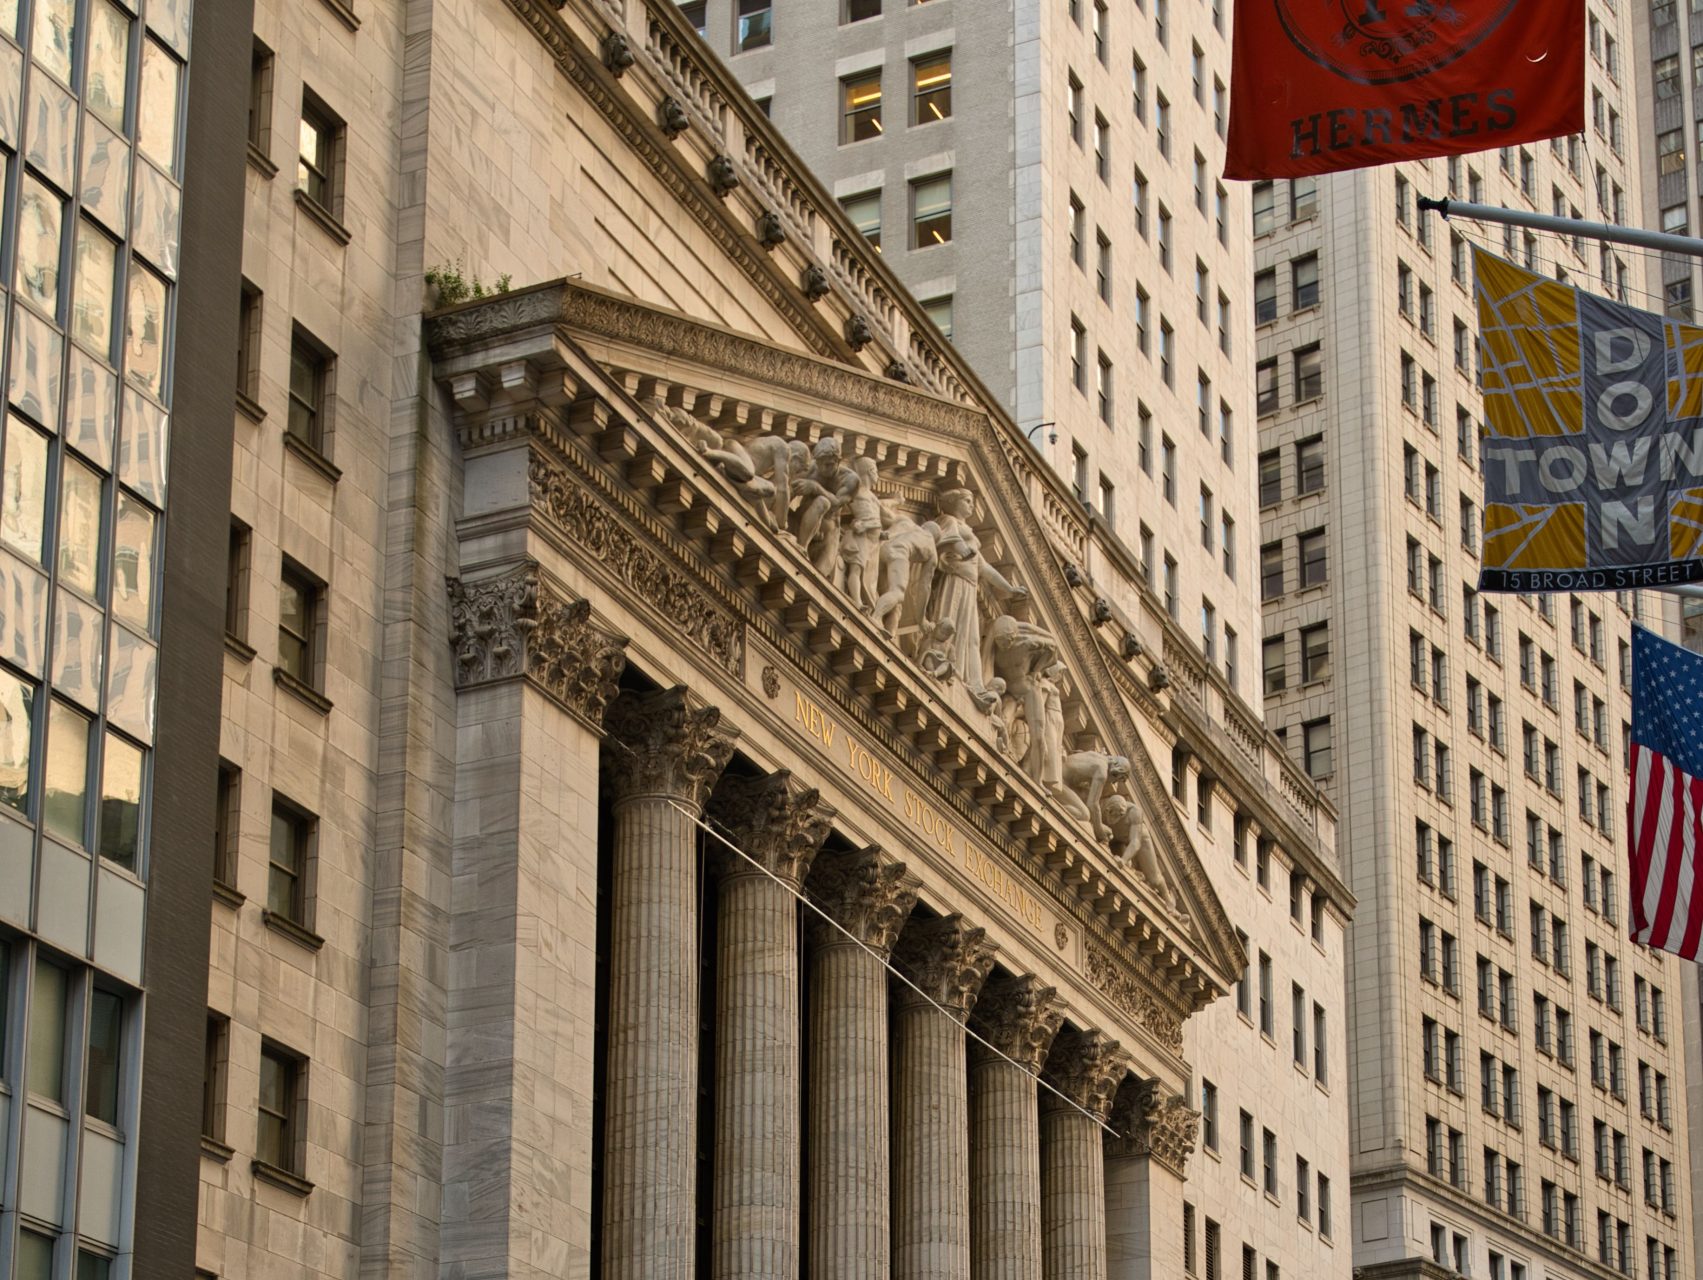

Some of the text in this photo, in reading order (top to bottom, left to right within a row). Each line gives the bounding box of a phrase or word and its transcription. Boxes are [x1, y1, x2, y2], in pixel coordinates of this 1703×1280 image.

[1289, 88, 1518, 160] HERMES
[1487, 428, 1703, 496] TOWN
[1501, 572, 1521, 589] 15
[1530, 571, 1606, 589] BROAD
[1615, 563, 1693, 586] STREET
[795, 691, 1044, 933] NEW YORK STOCK EXCHANGE
